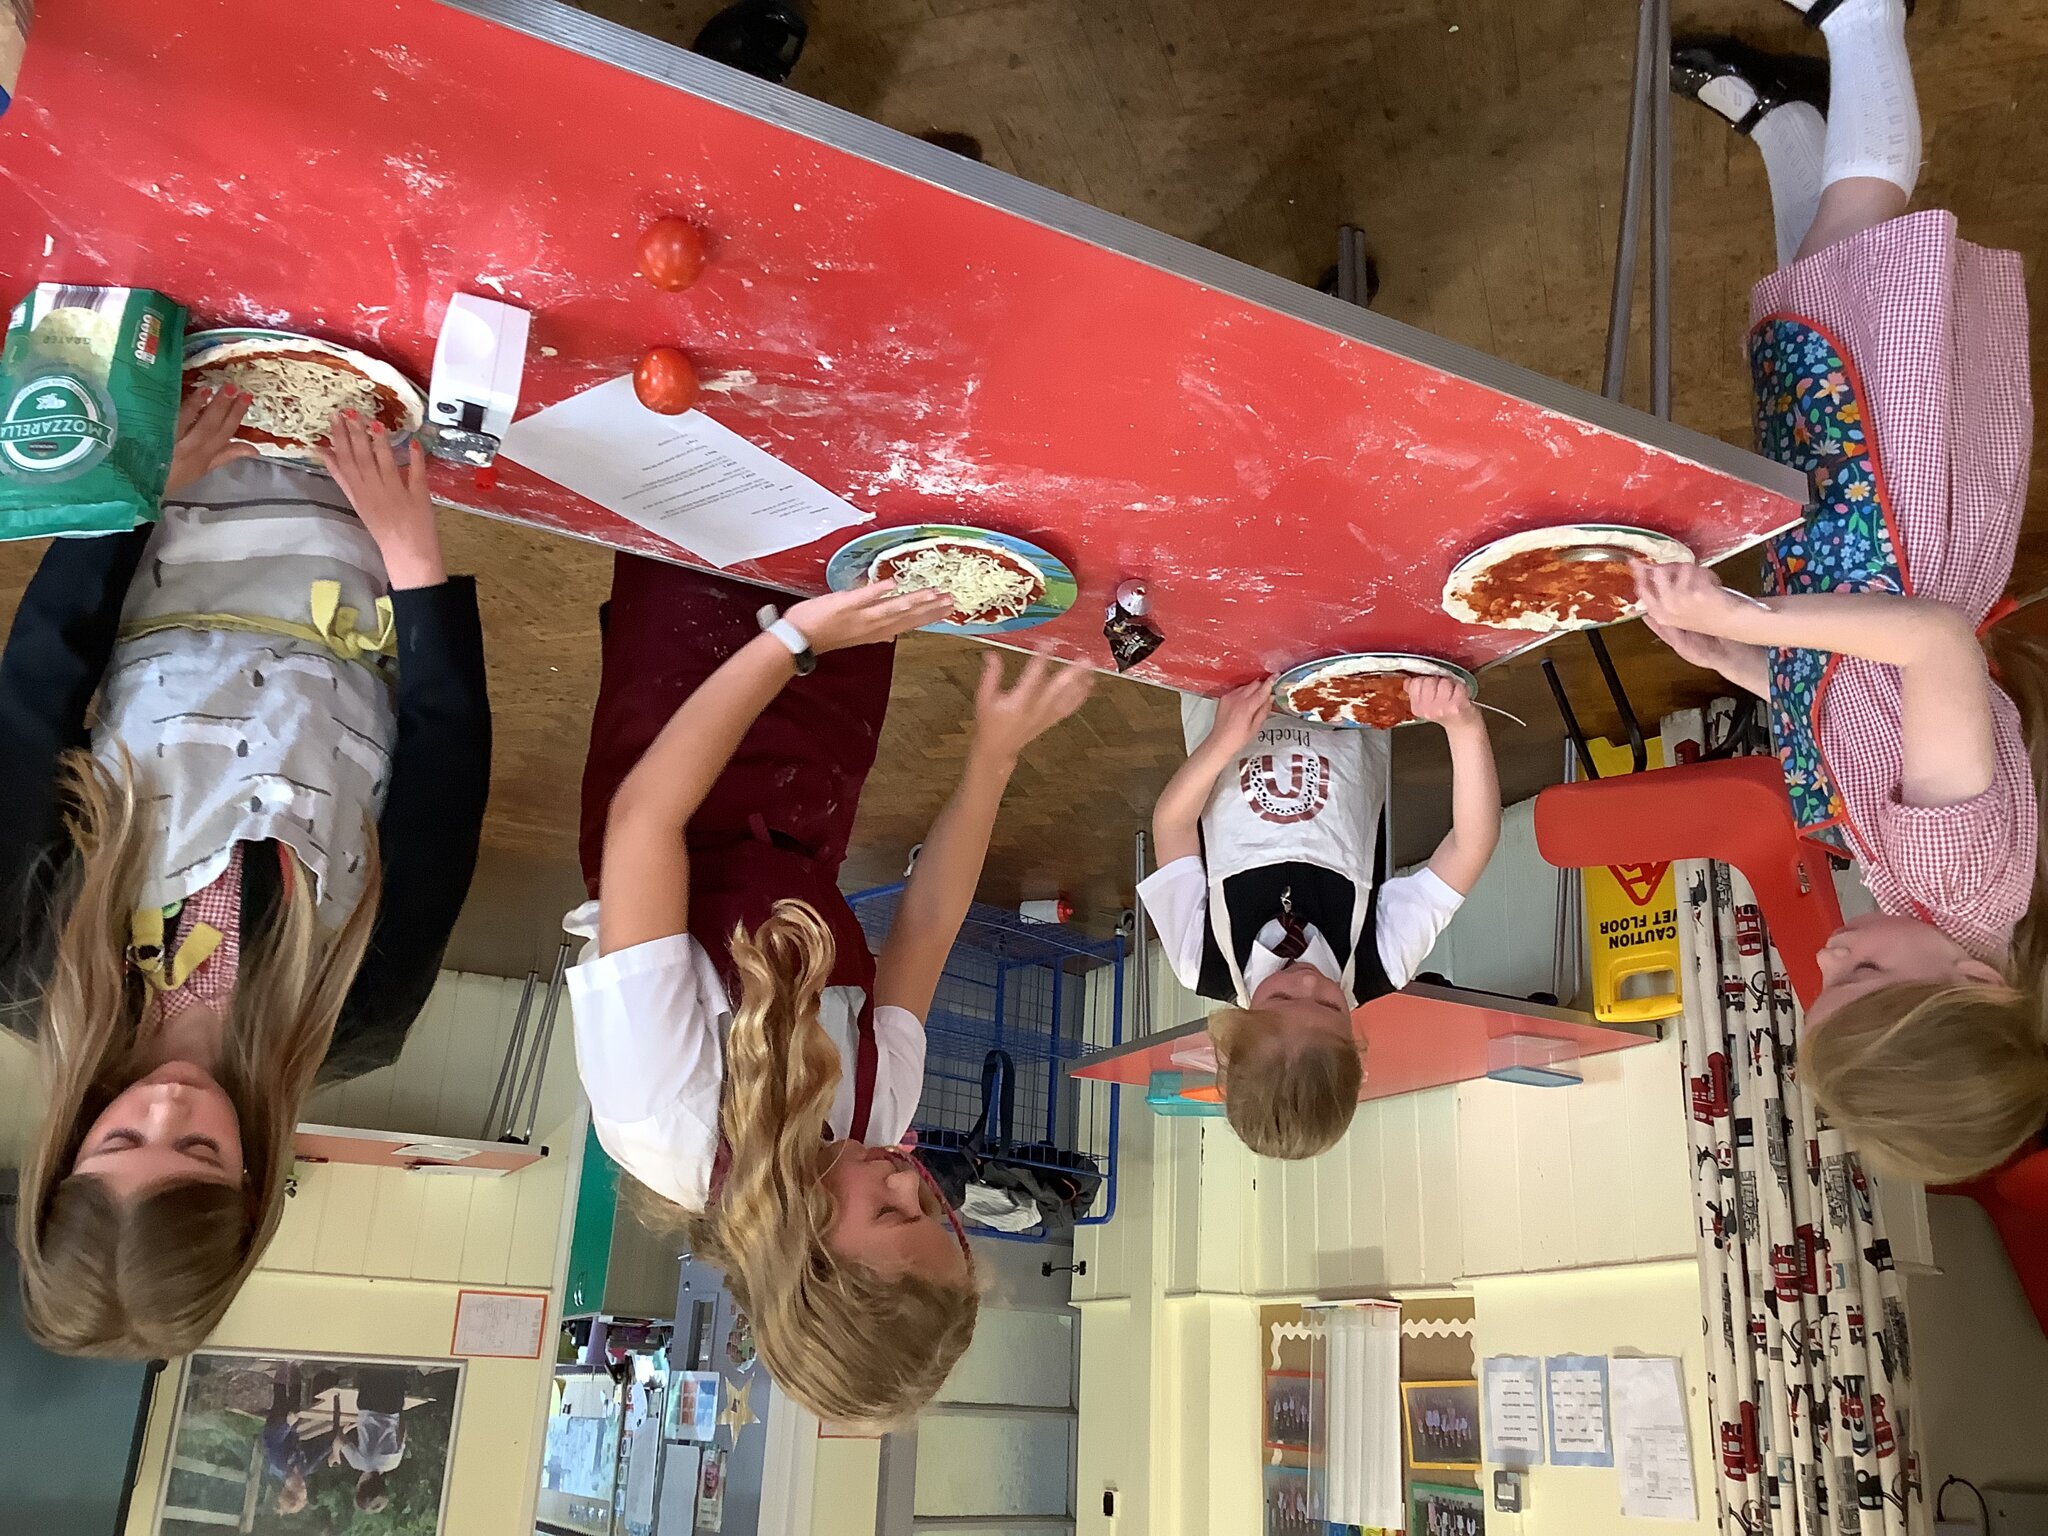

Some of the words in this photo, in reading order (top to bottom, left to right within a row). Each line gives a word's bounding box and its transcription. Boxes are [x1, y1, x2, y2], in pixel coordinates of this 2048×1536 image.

[0, 419, 103, 437] MOZZARELLA
[1257, 728, 1311, 747] Phoebe
[1599, 915, 1647, 935] FLOOR
[1608, 926, 1677, 949] CAUTION
